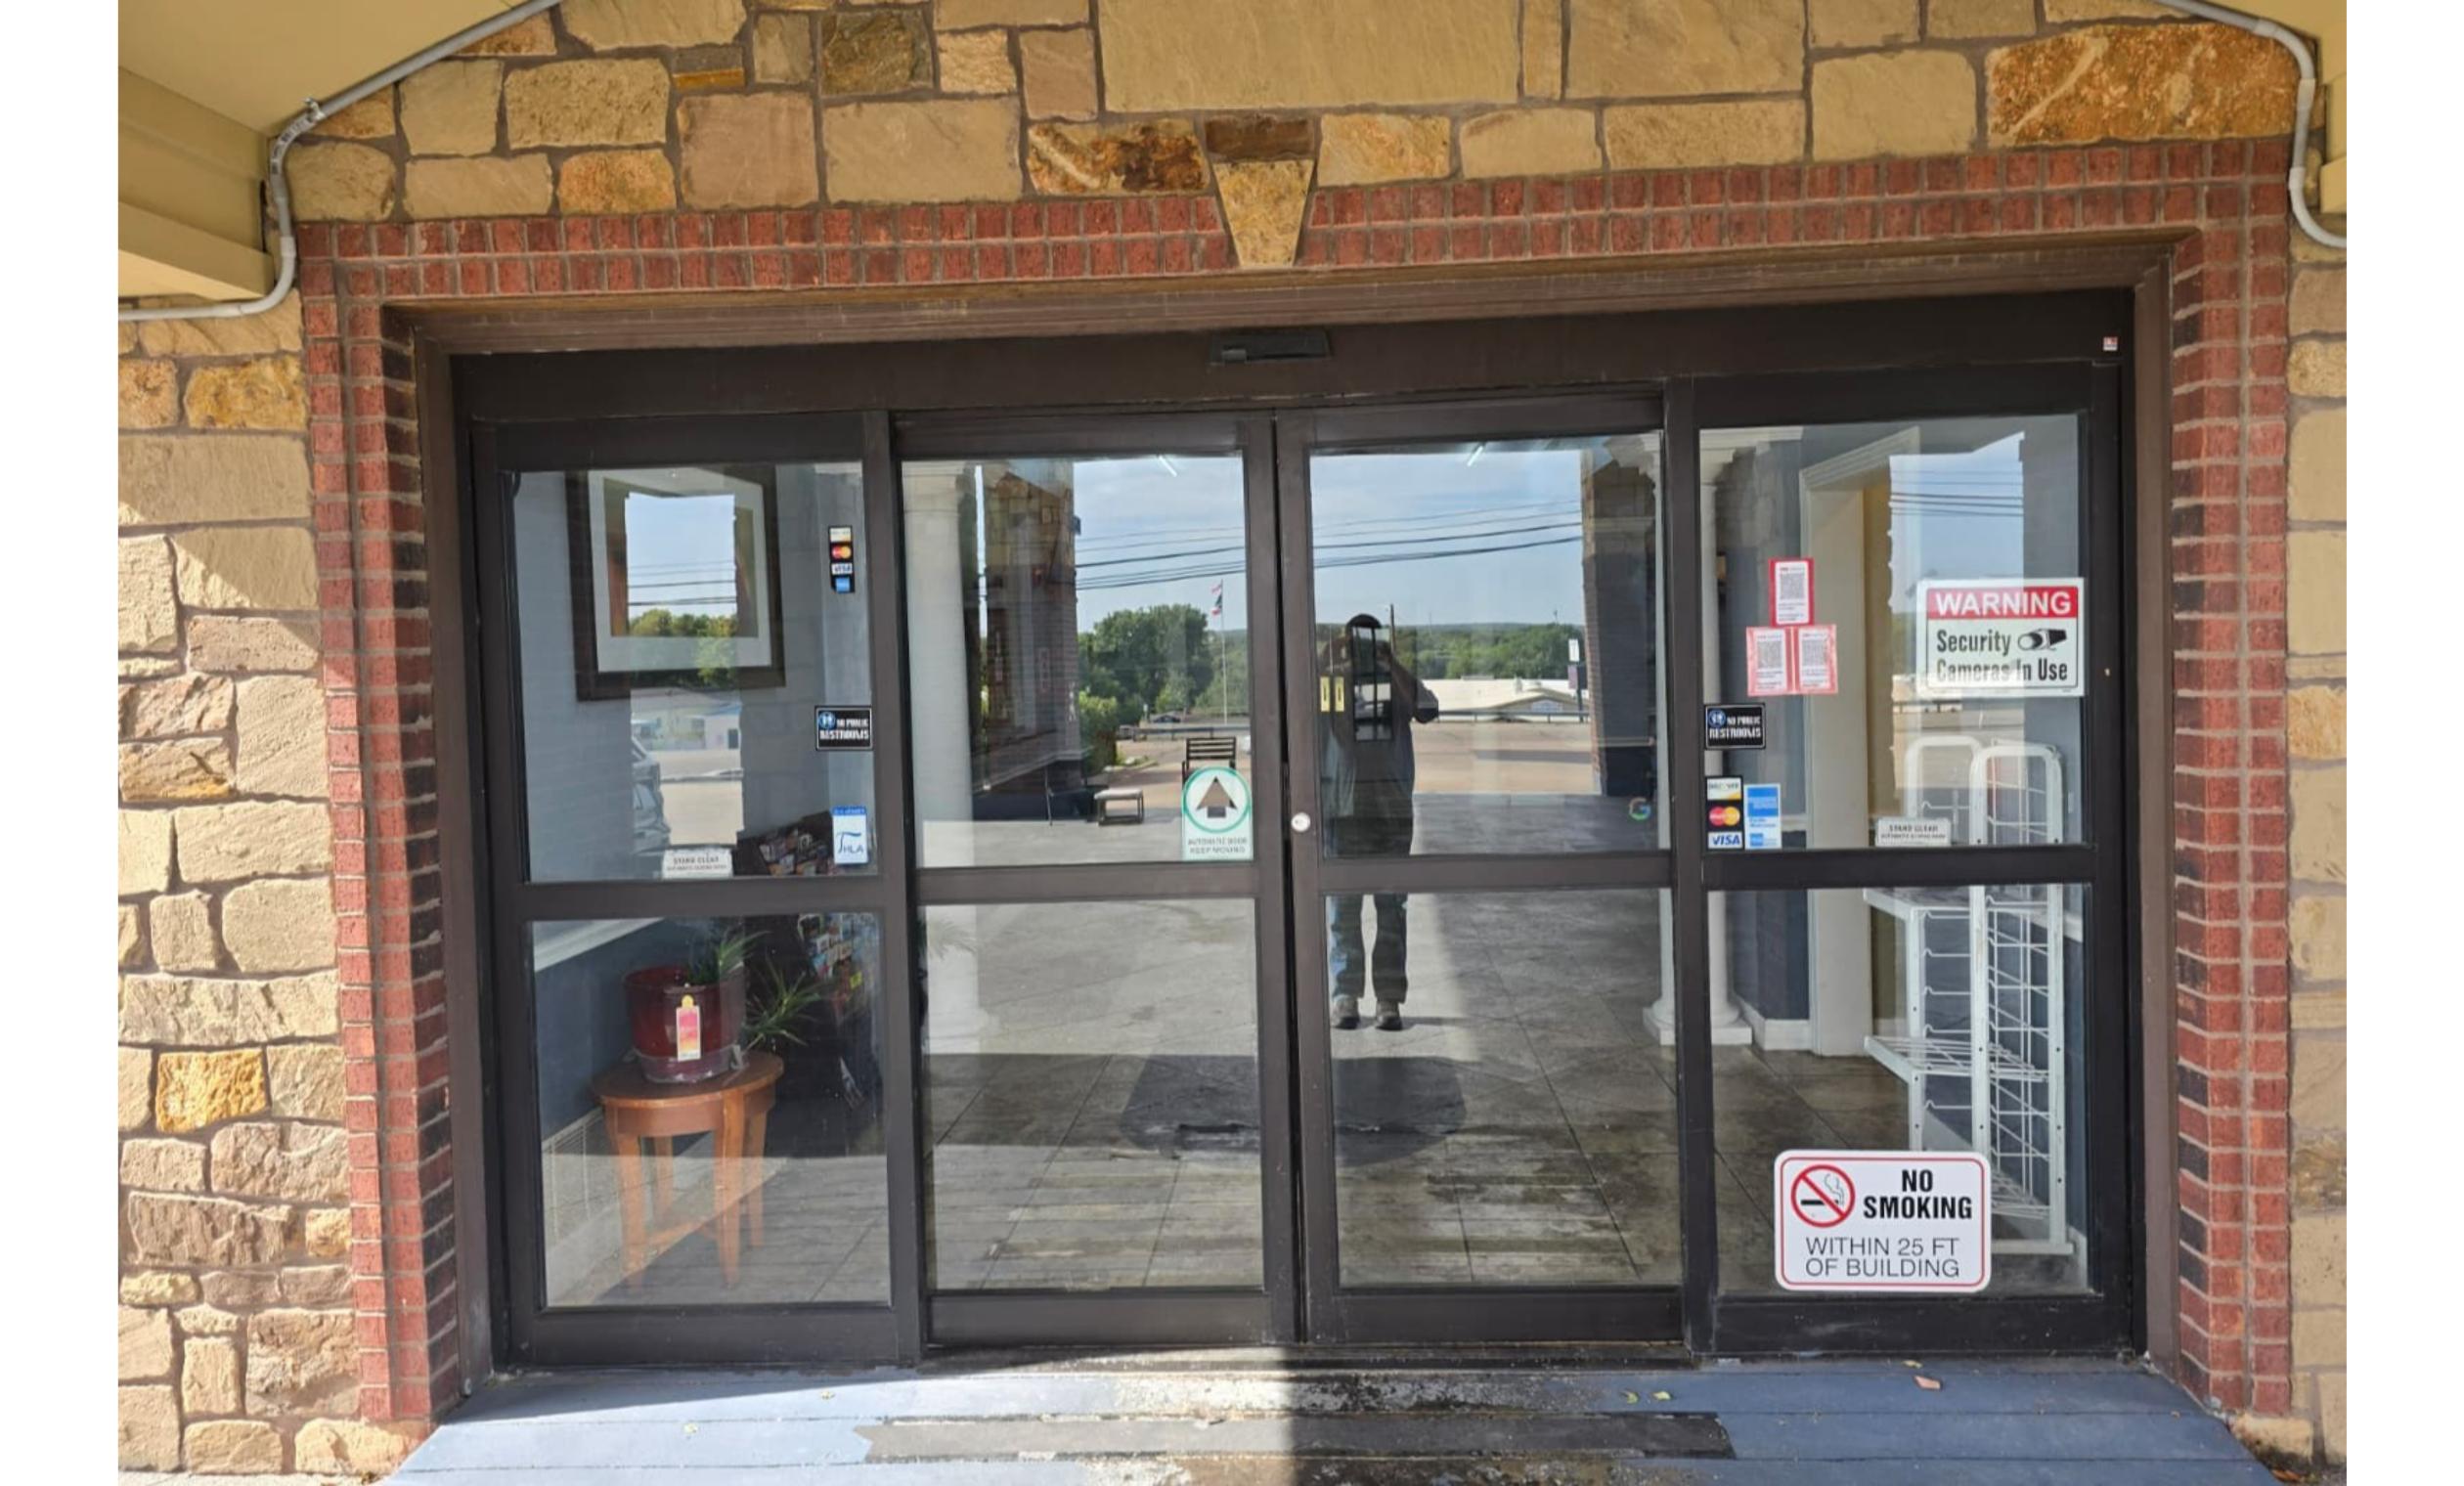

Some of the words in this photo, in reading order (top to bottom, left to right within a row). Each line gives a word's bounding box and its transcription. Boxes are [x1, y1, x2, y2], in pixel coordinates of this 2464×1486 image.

[1936, 590, 2072, 616] WARNING
[1937, 629, 2011, 656] Security
[1937, 658, 2010, 681] Cameras
[2016, 658, 2032, 681] In
[2038, 658, 2068, 681] Use
[819, 729, 869, 740] RESTROOMS
[1709, 727, 1761, 739] RESTROOMS
[1712, 834, 1740, 846] VISA
[1902, 1169, 1933, 1192] NO
[1864, 1196, 1972, 1219] SMOKING
[1806, 1237, 1889, 1256] WITHIN
[1898, 1238, 1923, 1256] 25
[1932, 1238, 1959, 1256] FT
[1806, 1257, 1838, 1277] OF
[1846, 1258, 1959, 1278] BUILDING
